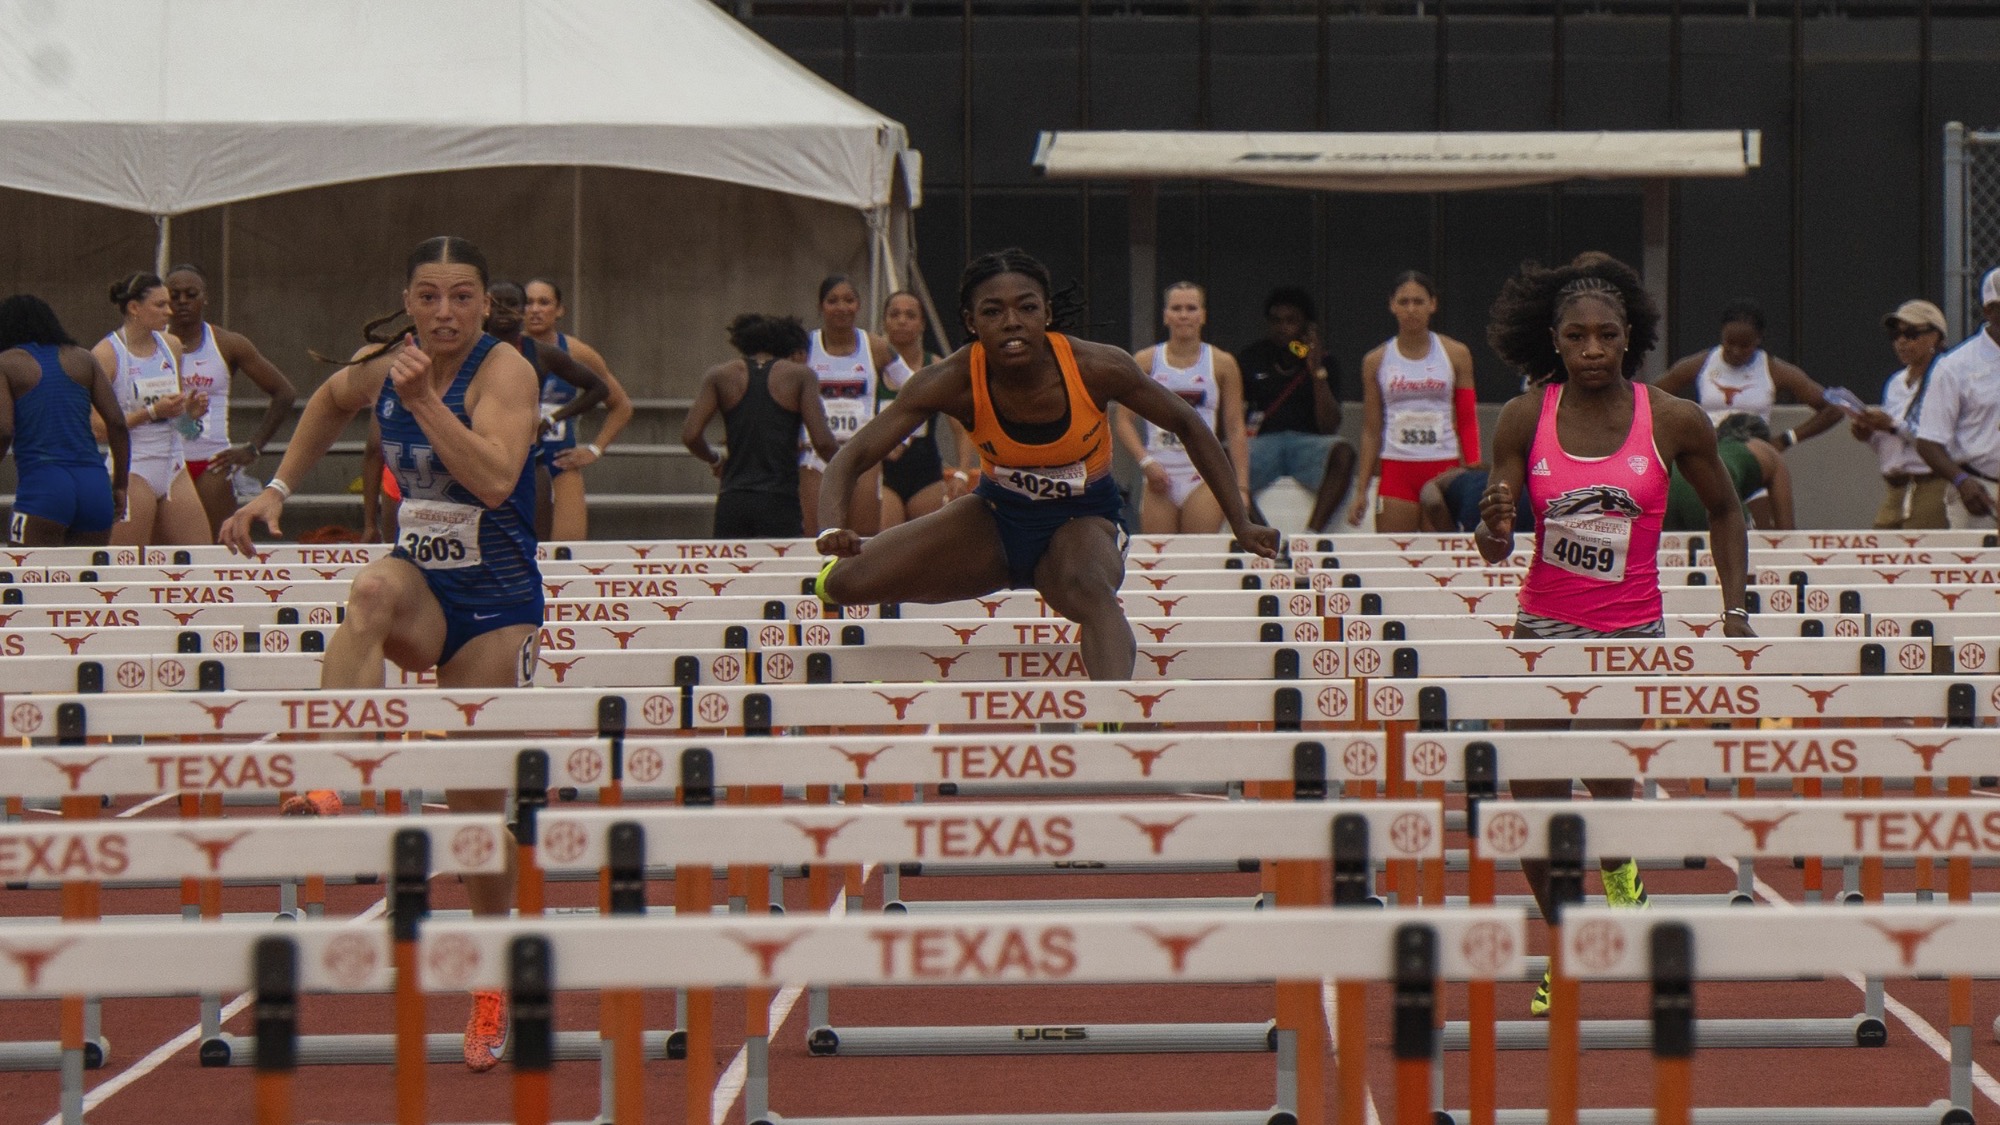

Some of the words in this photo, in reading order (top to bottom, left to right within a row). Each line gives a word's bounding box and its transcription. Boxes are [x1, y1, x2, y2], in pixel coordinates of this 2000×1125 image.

[826, 415, 858, 431] 910
[1008, 471, 1072, 499] 4029
[405, 533, 466, 562] 3603
[677, 544, 748, 559] TEXAS
[1553, 537, 1615, 573] 4059
[1808, 535, 1878, 548] TEXAS
[298, 549, 370, 563] TEXAS
[595, 580, 678, 597] TEXAS
[1930, 570, 2000, 584] TEXA
[149, 587, 234, 603] TEXAS
[1289, 595, 1312, 616] SEC
[1329, 592, 1351, 614] SEC
[1770, 590, 1792, 612] SEC
[1807, 590, 1830, 612] SEC
[46, 610, 140, 626] TEXAS
[544, 603, 629, 621] TEXAS
[796, 600, 819, 619] SEC
[760, 626, 785, 646] SEC
[806, 625, 831, 646] SEC
[1294, 622, 1319, 642] SEC
[1347, 620, 1372, 641] SEC
[1834, 619, 1860, 637] SEC
[1875, 618, 1900, 637] SEC
[213, 631, 238, 653] SEC
[264, 630, 290, 653] SEC
[712, 655, 741, 682] SEC
[766, 652, 794, 679] SEC
[998, 651, 1088, 677] TEXA
[1312, 648, 1340, 675] SEC
[1353, 647, 1381, 674] SEC
[1584, 645, 1695, 672] TEXAS
[1899, 643, 1926, 670] SEC
[1958, 642, 1986, 670] SEC
[117, 661, 145, 688] SEC
[157, 660, 186, 687] SEC
[643, 695, 674, 725] SEC
[698, 692, 729, 723] SEC
[961, 689, 1087, 720] TEXAS
[1317, 686, 1348, 717] SEC
[1373, 685, 1404, 716] SEC
[1634, 684, 1760, 715] TEXAS
[281, 699, 410, 729] TEXAS
[932, 744, 1077, 779] TEXAS
[1343, 740, 1378, 776] SEC
[1412, 740, 1447, 776] SEC
[1714, 739, 1859, 774] TEXAS
[147, 753, 296, 789] TEXAS
[905, 815, 1075, 858] TEXAS
[1844, 810, 2000, 852] TEXAS
[0, 834, 130, 876] EXAS
[867, 926, 1078, 978] TEXAS
[1017, 1027, 1087, 1040] UCS
